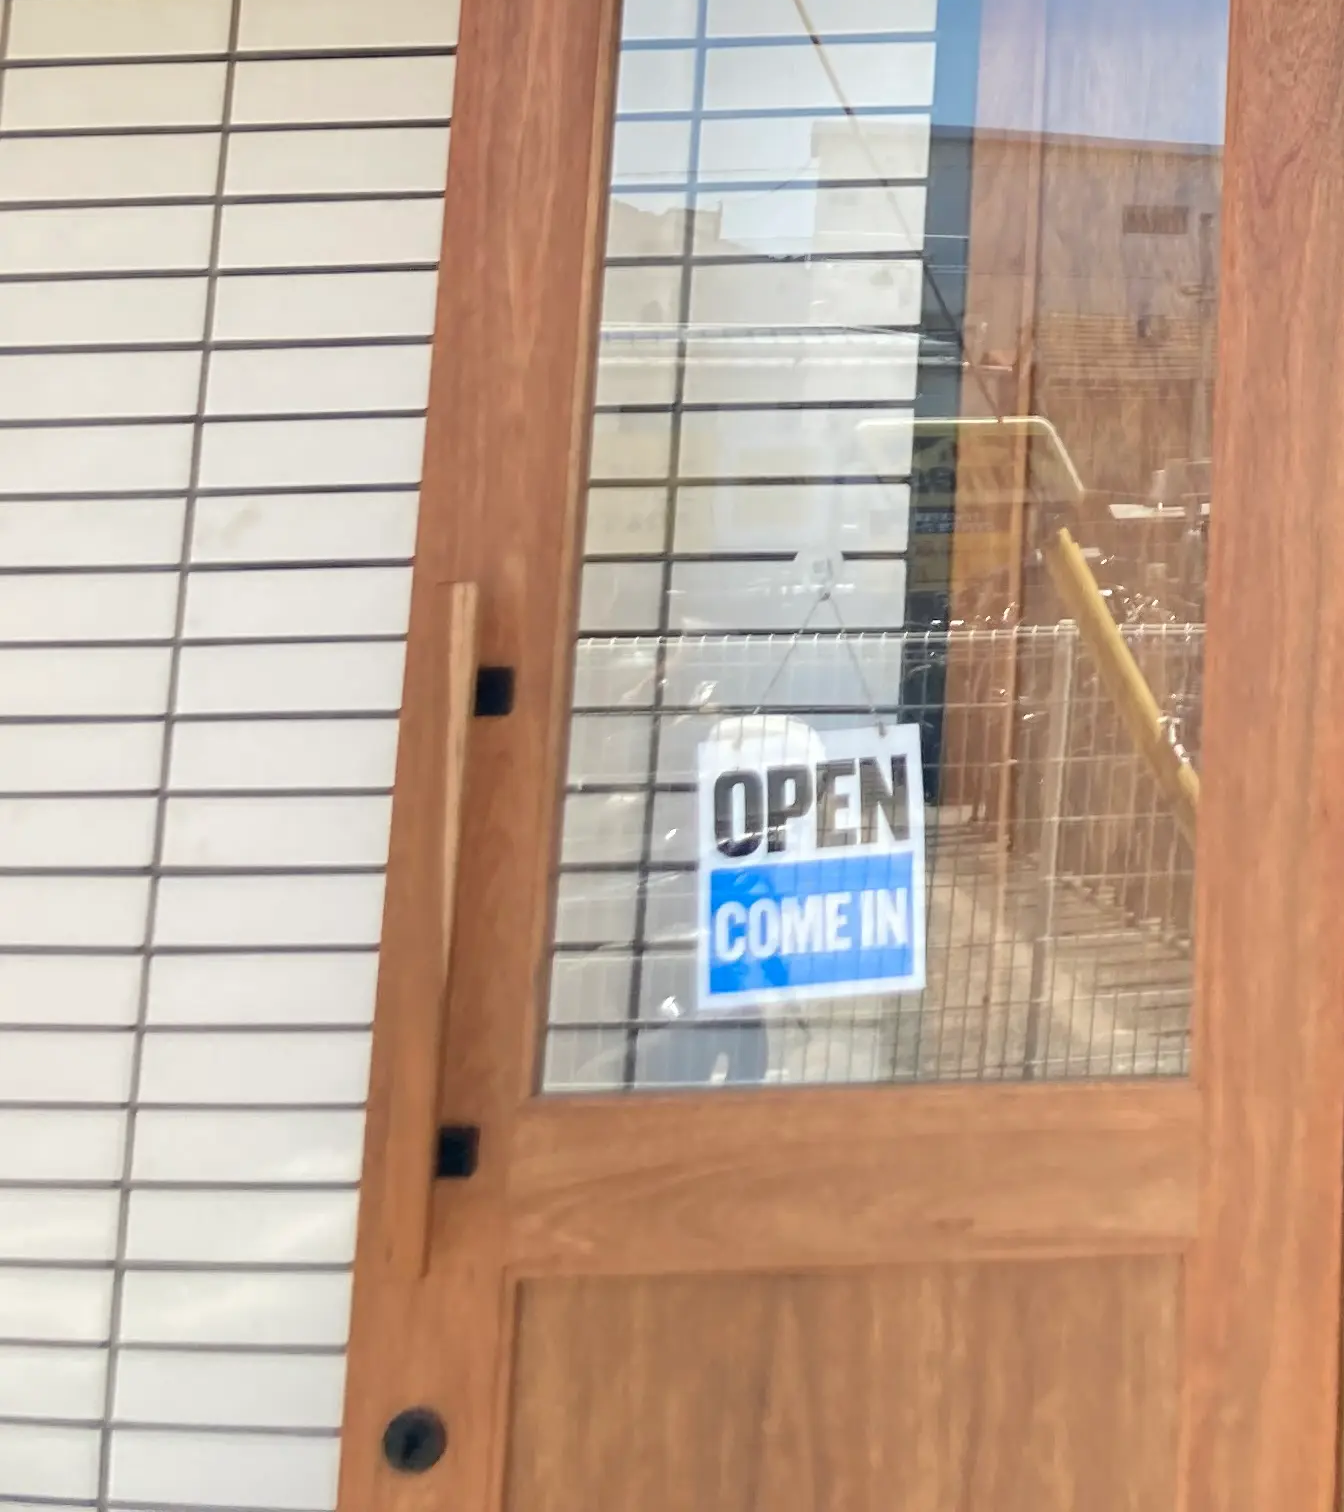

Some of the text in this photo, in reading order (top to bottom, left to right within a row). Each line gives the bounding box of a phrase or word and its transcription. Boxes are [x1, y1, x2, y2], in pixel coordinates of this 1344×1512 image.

[714, 754, 911, 858] OPEN
[715, 888, 908, 962] COME IN
